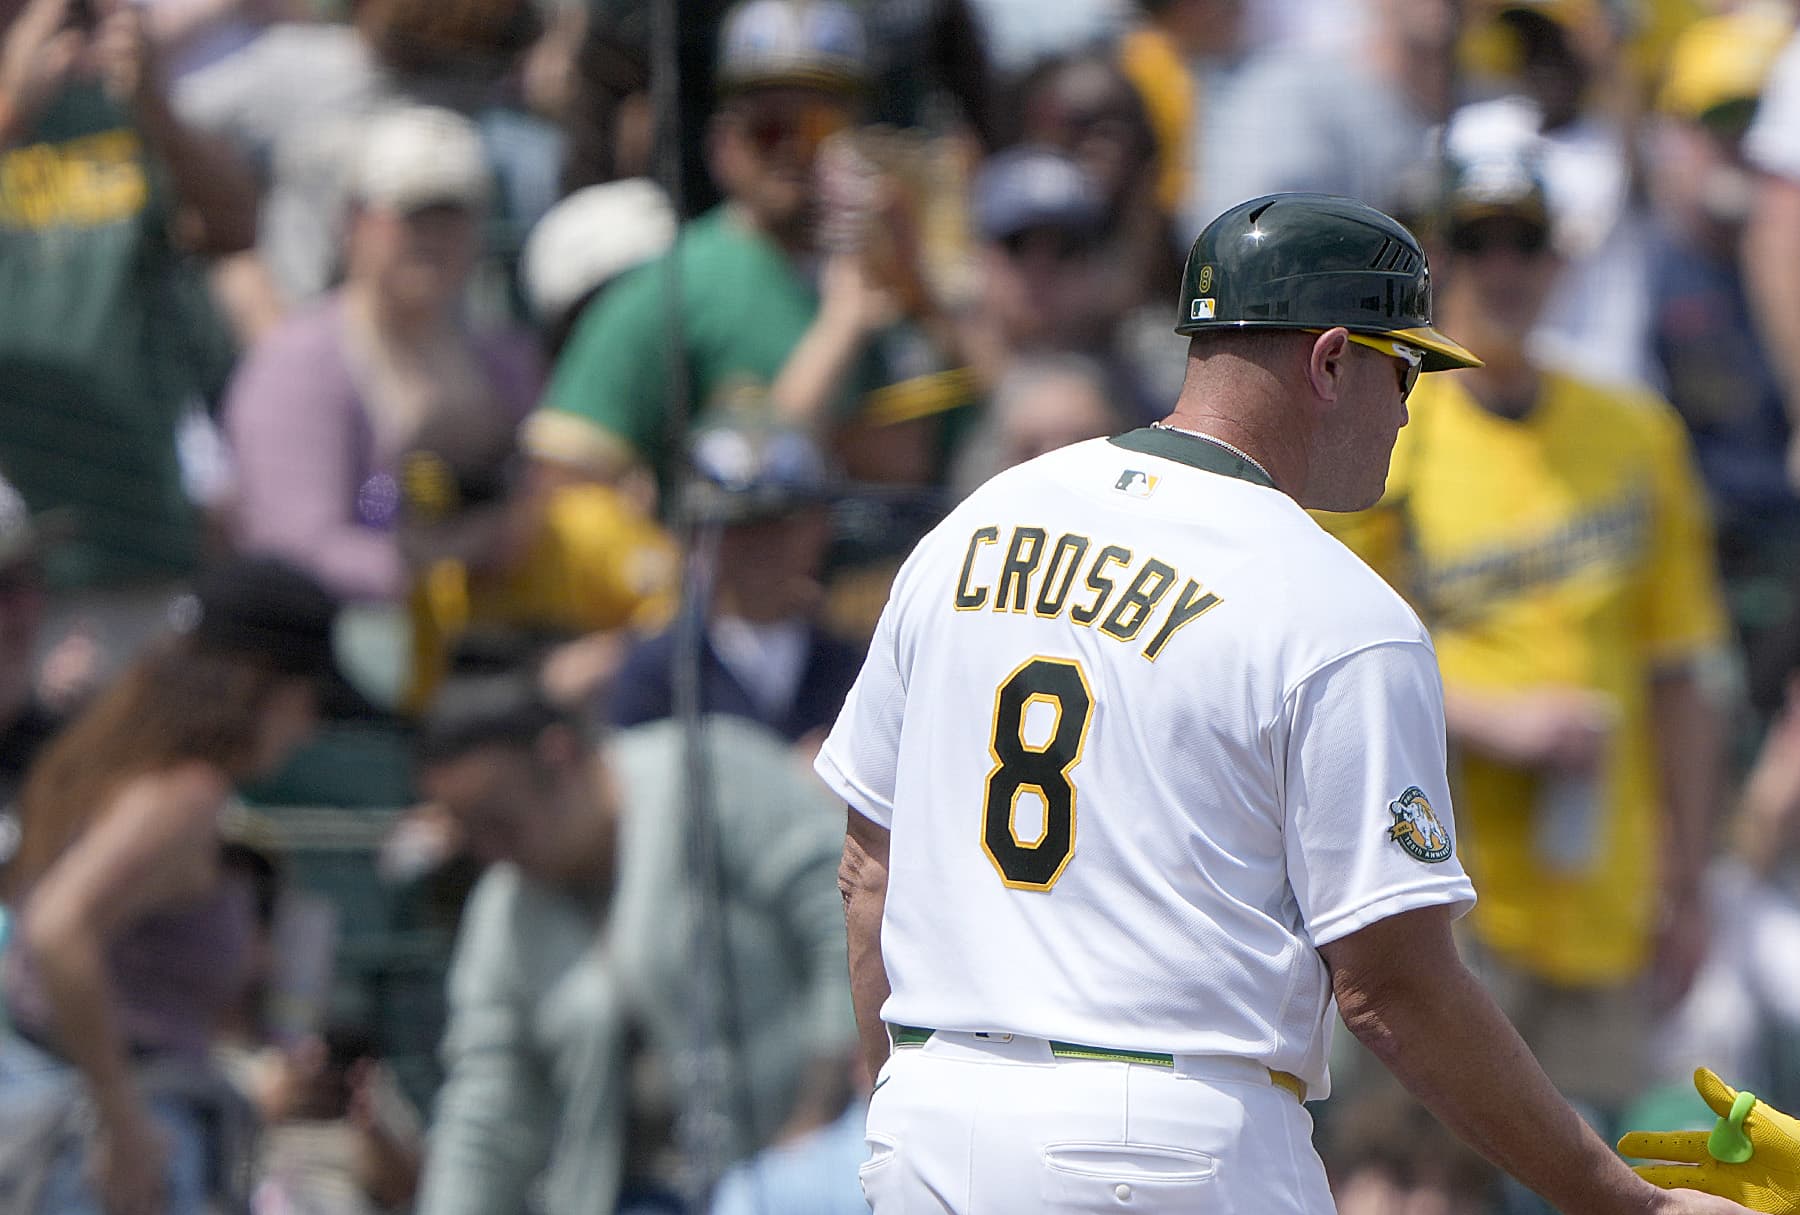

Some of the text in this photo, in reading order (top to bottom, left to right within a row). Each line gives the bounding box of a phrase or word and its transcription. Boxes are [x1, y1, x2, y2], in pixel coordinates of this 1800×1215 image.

[1199, 265, 1213, 294] 8
[953, 525, 1224, 662] CROSBY
[980, 655, 1095, 892] 8
